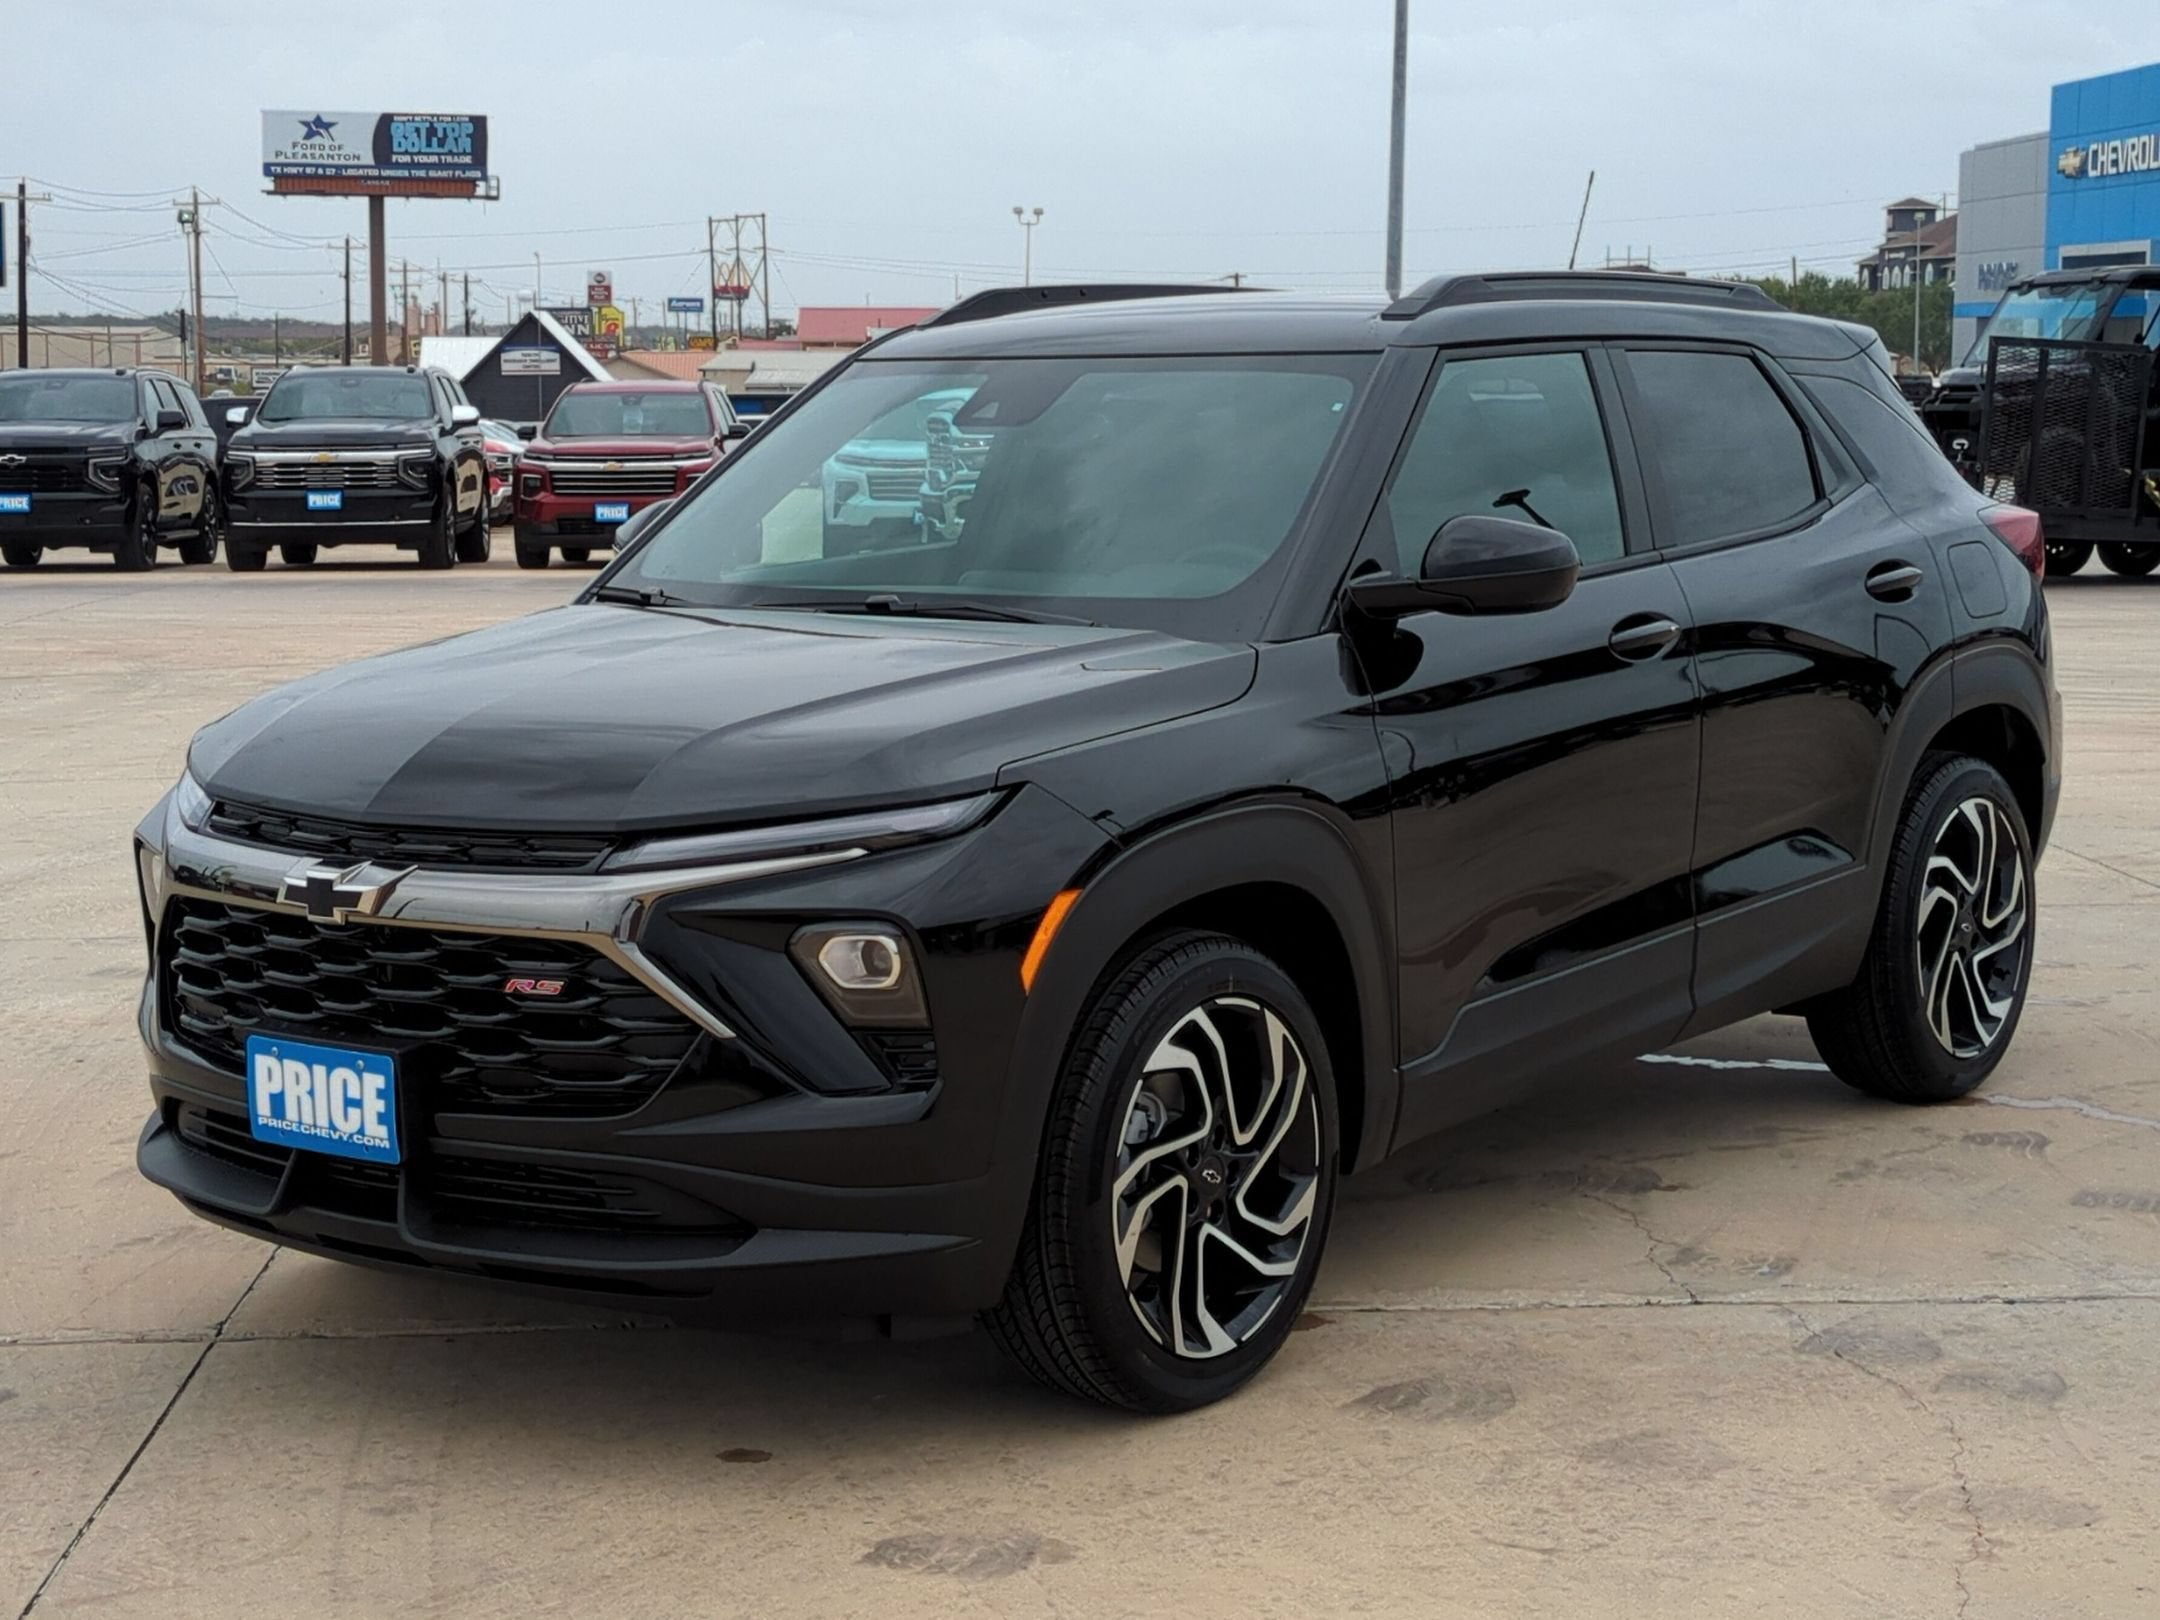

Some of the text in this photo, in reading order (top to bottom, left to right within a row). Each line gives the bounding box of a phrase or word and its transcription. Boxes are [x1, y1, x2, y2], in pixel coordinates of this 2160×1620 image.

[433, 122, 474, 138] TOP
[291, 141, 344, 152] FORD OF
[392, 134, 472, 153] DOLLAR
[274, 151, 361, 161] PLEASANTON
[392, 154, 472, 164] FOR YOUR TRADE
[2087, 133, 2160, 178] CHEVROL
[342, 168, 379, 176] LOCATED
[309, 494, 341, 507] PRICE
[597, 505, 628, 519] PRICE
[504, 978, 565, 995] RS
[254, 1053, 389, 1139] PRICE
[257, 1115, 391, 1149] PRICECHEVY.COM
